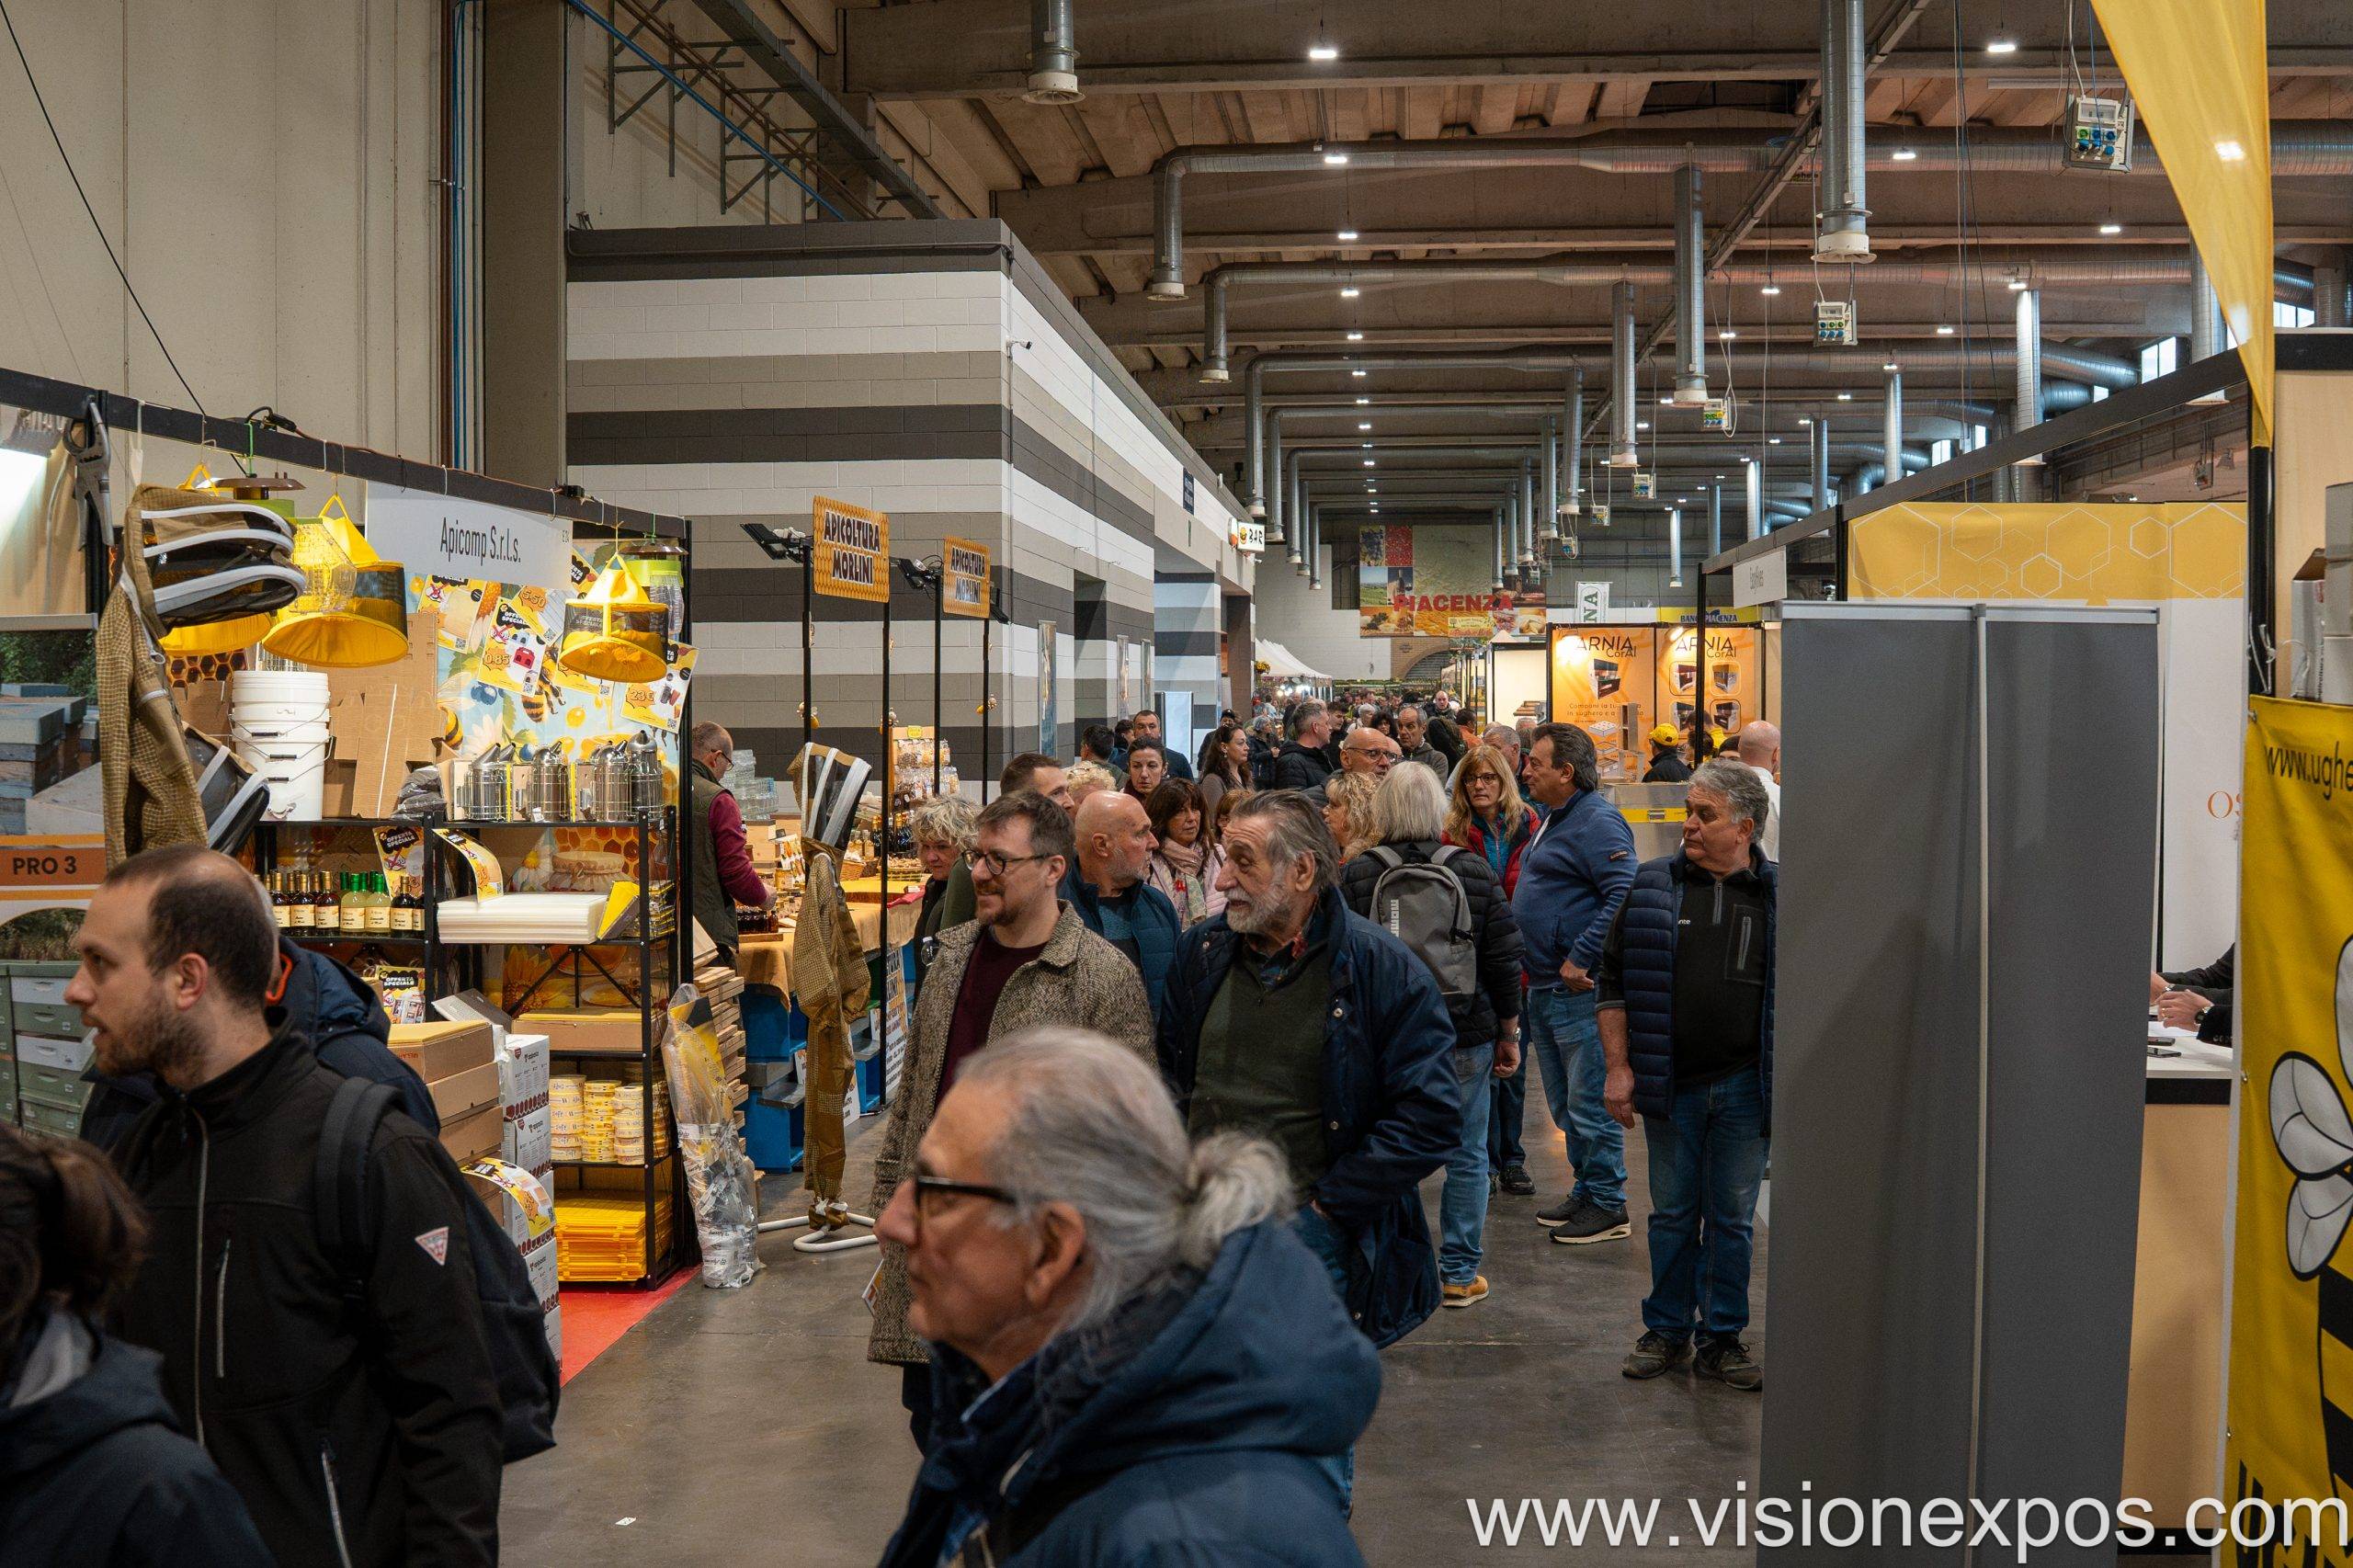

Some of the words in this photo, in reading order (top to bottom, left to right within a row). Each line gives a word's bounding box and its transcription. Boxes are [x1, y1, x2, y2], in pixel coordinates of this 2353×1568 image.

[440, 517, 487, 566] Apicomp
[490, 525, 521, 562] S.r.l.s.
[824, 509, 881, 554] APICOLTURA
[1249, 528, 1263, 545] BAR
[832, 549, 874, 586] MORLINI
[950, 545, 986, 578] APICOLTURA
[955, 576, 982, 604] MORLINI
[1393, 594, 1514, 612] PIACENZA
[1577, 636, 1633, 652] ARNIA
[386, 835, 415, 848] SPECIALE
[13, 857, 59, 875] PRO
[64, 856, 77, 874] 3
